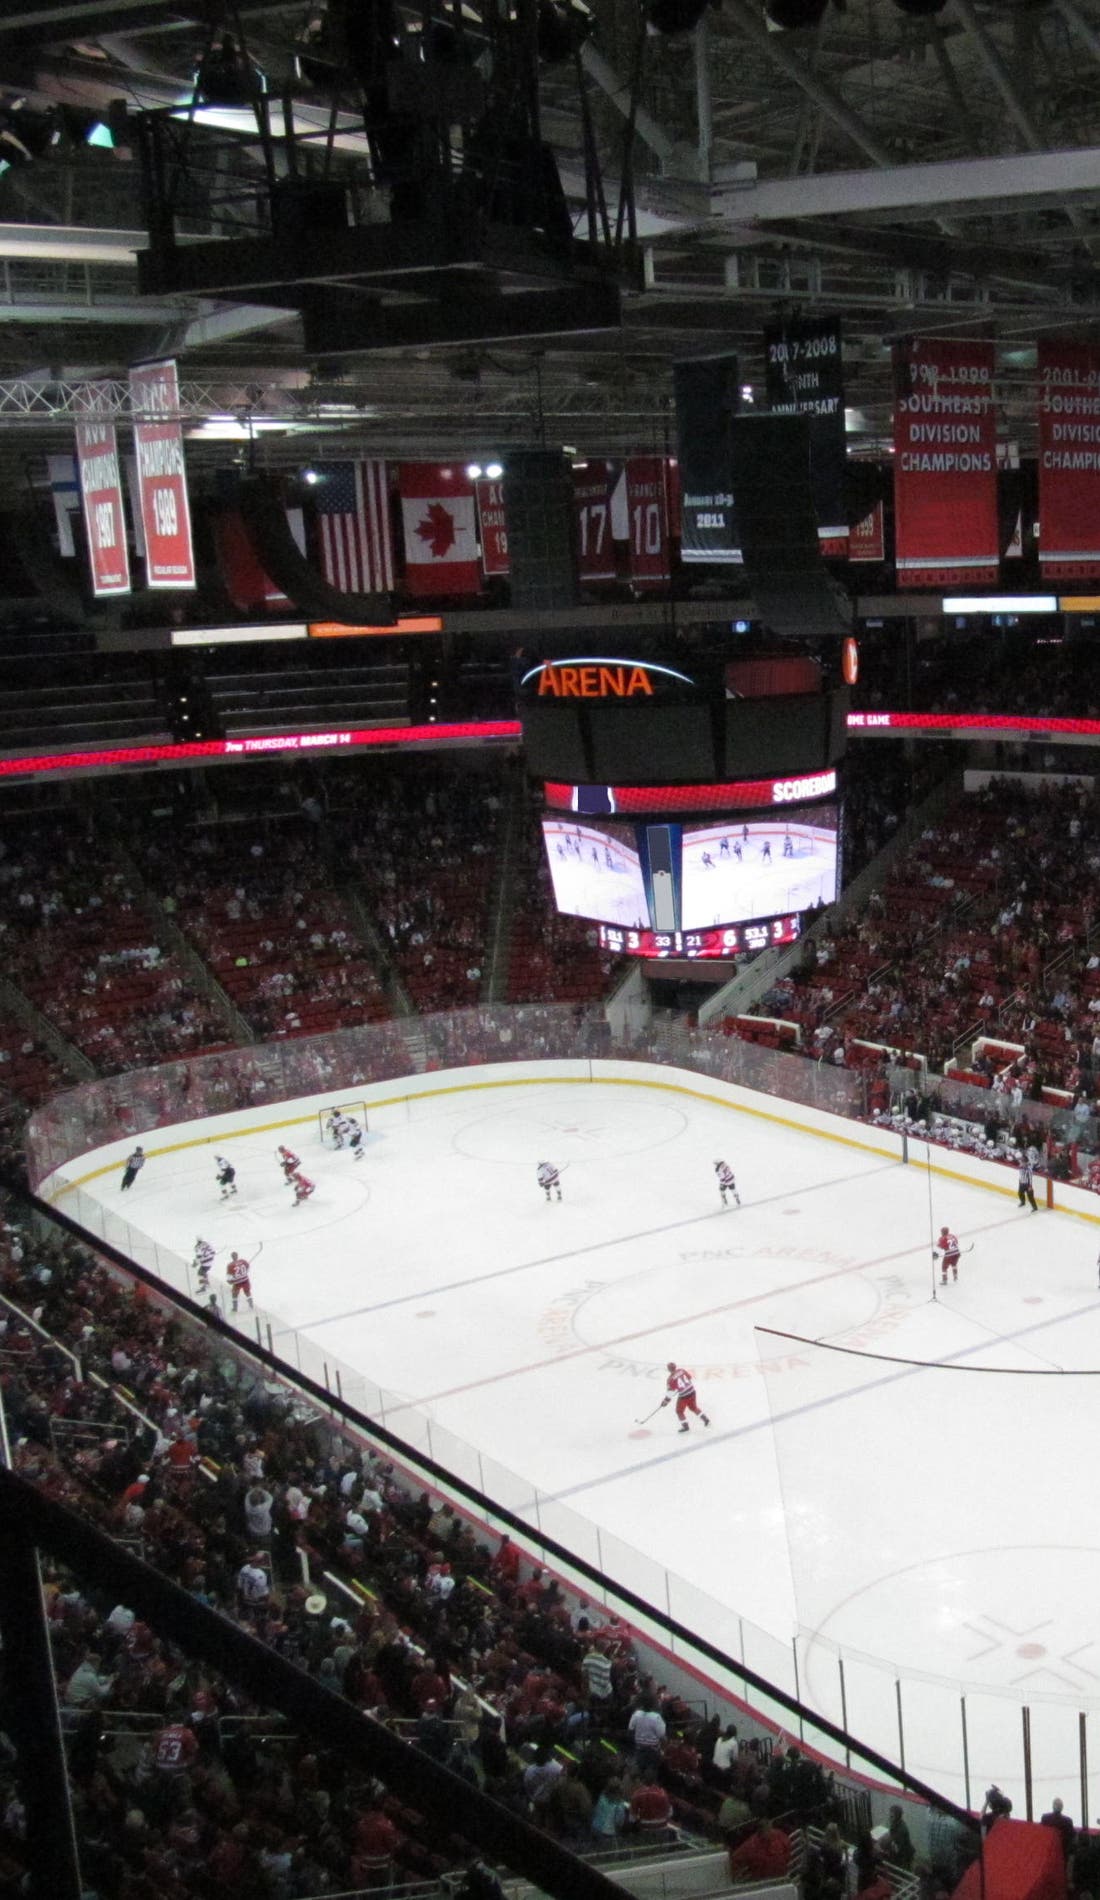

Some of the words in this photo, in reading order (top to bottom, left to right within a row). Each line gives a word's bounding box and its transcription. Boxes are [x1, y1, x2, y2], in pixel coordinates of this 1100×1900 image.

[909, 423, 980, 443] DIVISION
[901, 452, 991, 472] CHAMPIONS
[1042, 450, 1100, 470] CHAMPI
[633, 503, 661, 555] 10
[696, 512, 726, 529] 2011
[579, 504, 606, 556] 17
[538, 666, 654, 697] ARENA
[244, 737, 299, 752] THURSDAY,
[300, 734, 337, 747] MARCH
[339, 733, 350, 744] 14
[723, 929, 737, 947] 6
[773, 921, 783, 938] 3
[628, 932, 640, 949] 3
[655, 936, 671, 947] 33
[686, 936, 702, 947] 21
[233, 1264, 247, 1280] 20
